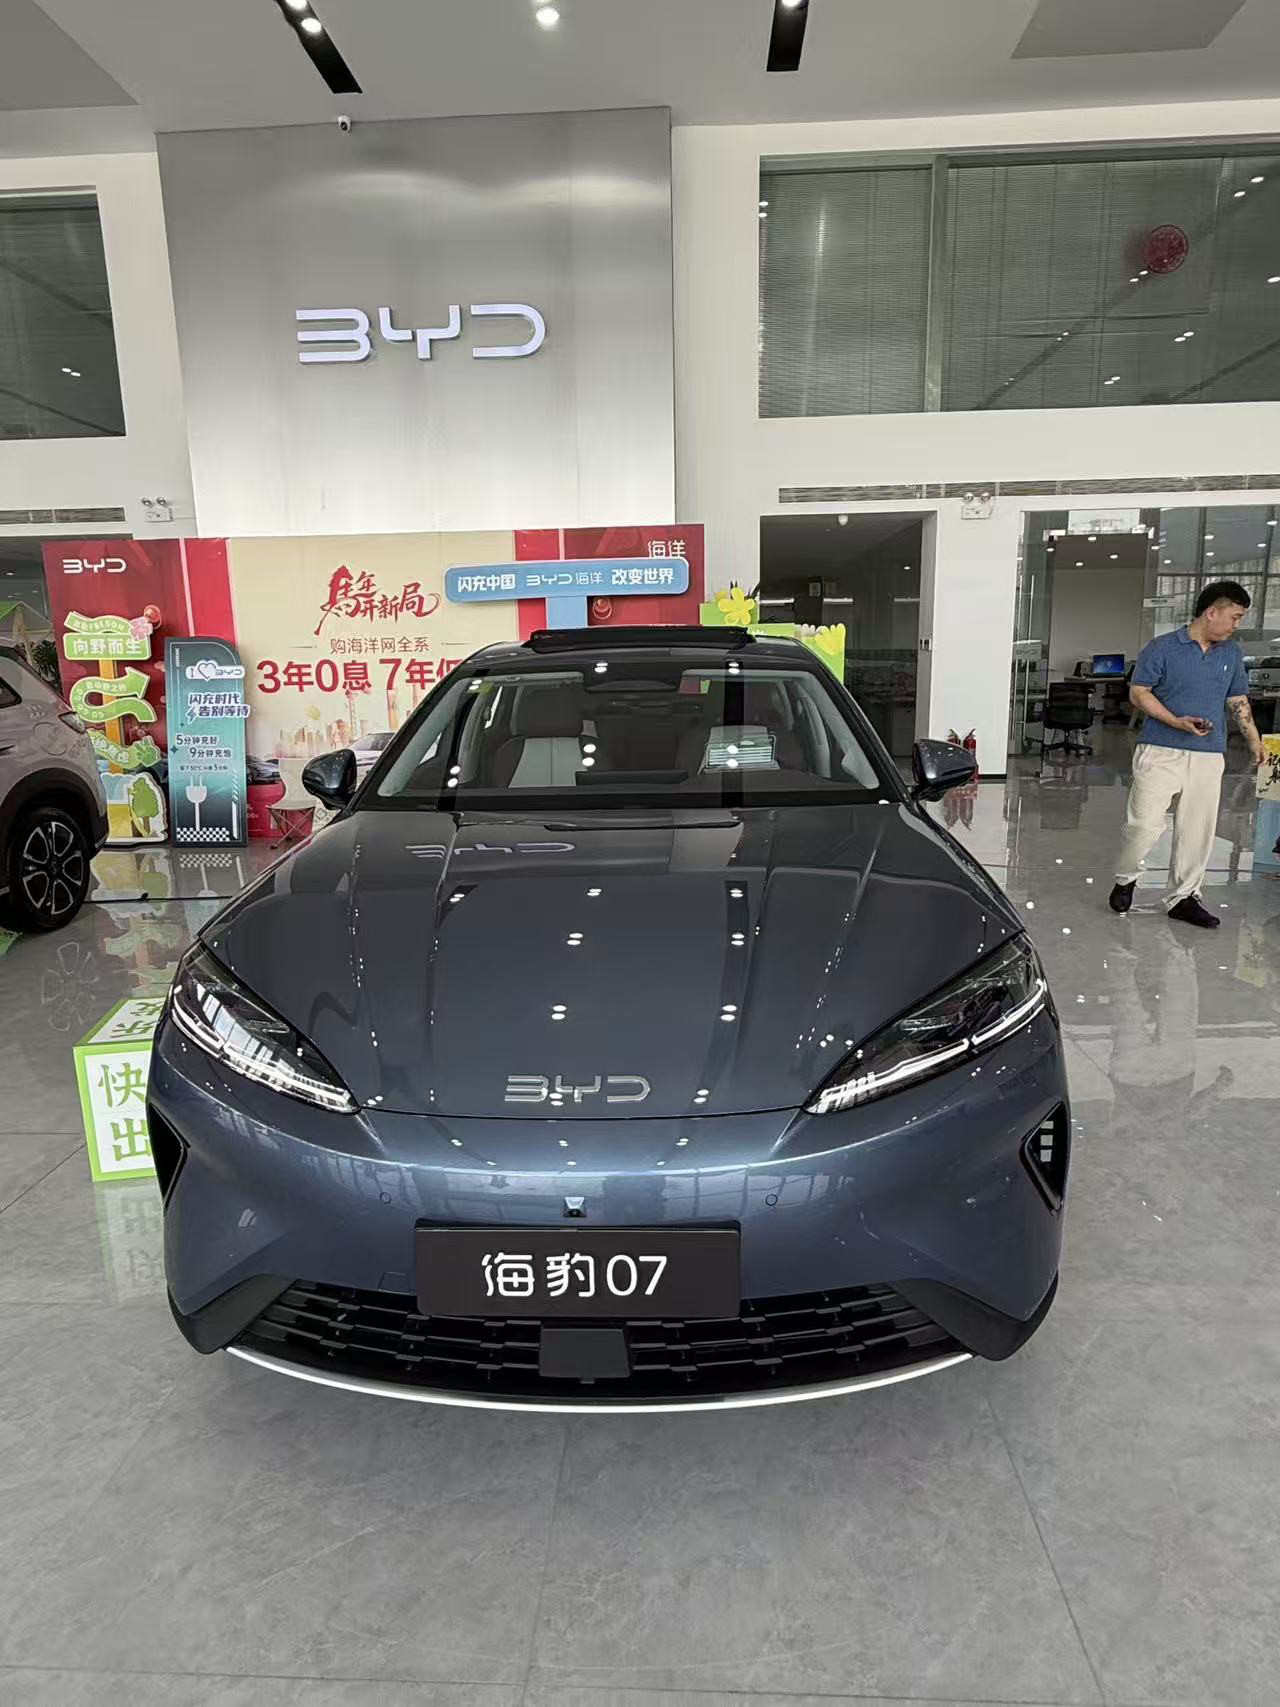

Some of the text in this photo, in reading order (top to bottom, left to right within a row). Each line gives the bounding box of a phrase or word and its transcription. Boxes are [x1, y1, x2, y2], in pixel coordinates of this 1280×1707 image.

[296, 303, 546, 363] BYD
[647, 540, 686, 558] 海洋
[62, 558, 127, 574] BYD
[457, 574, 516, 593] 闪充中国
[611, 568, 674, 586] 改变世界
[73, 638, 142, 655] 向野而生
[330, 637, 430, 655] 购海洋网全系
[215, 668, 243, 676] BYD
[256, 658, 372, 695] 3年0息
[189, 693, 240, 705] 闪充时代
[198, 705, 249, 717] 告别等待
[176, 734, 218, 745] 5分钟充好
[189, 747, 232, 758] 9分钟充饱
[98, 1062, 146, 1108] 快
[504, 1075, 651, 1103] BYD
[110, 1117, 150, 1162] 出
[481, 1252, 667, 1297] 海豹07
